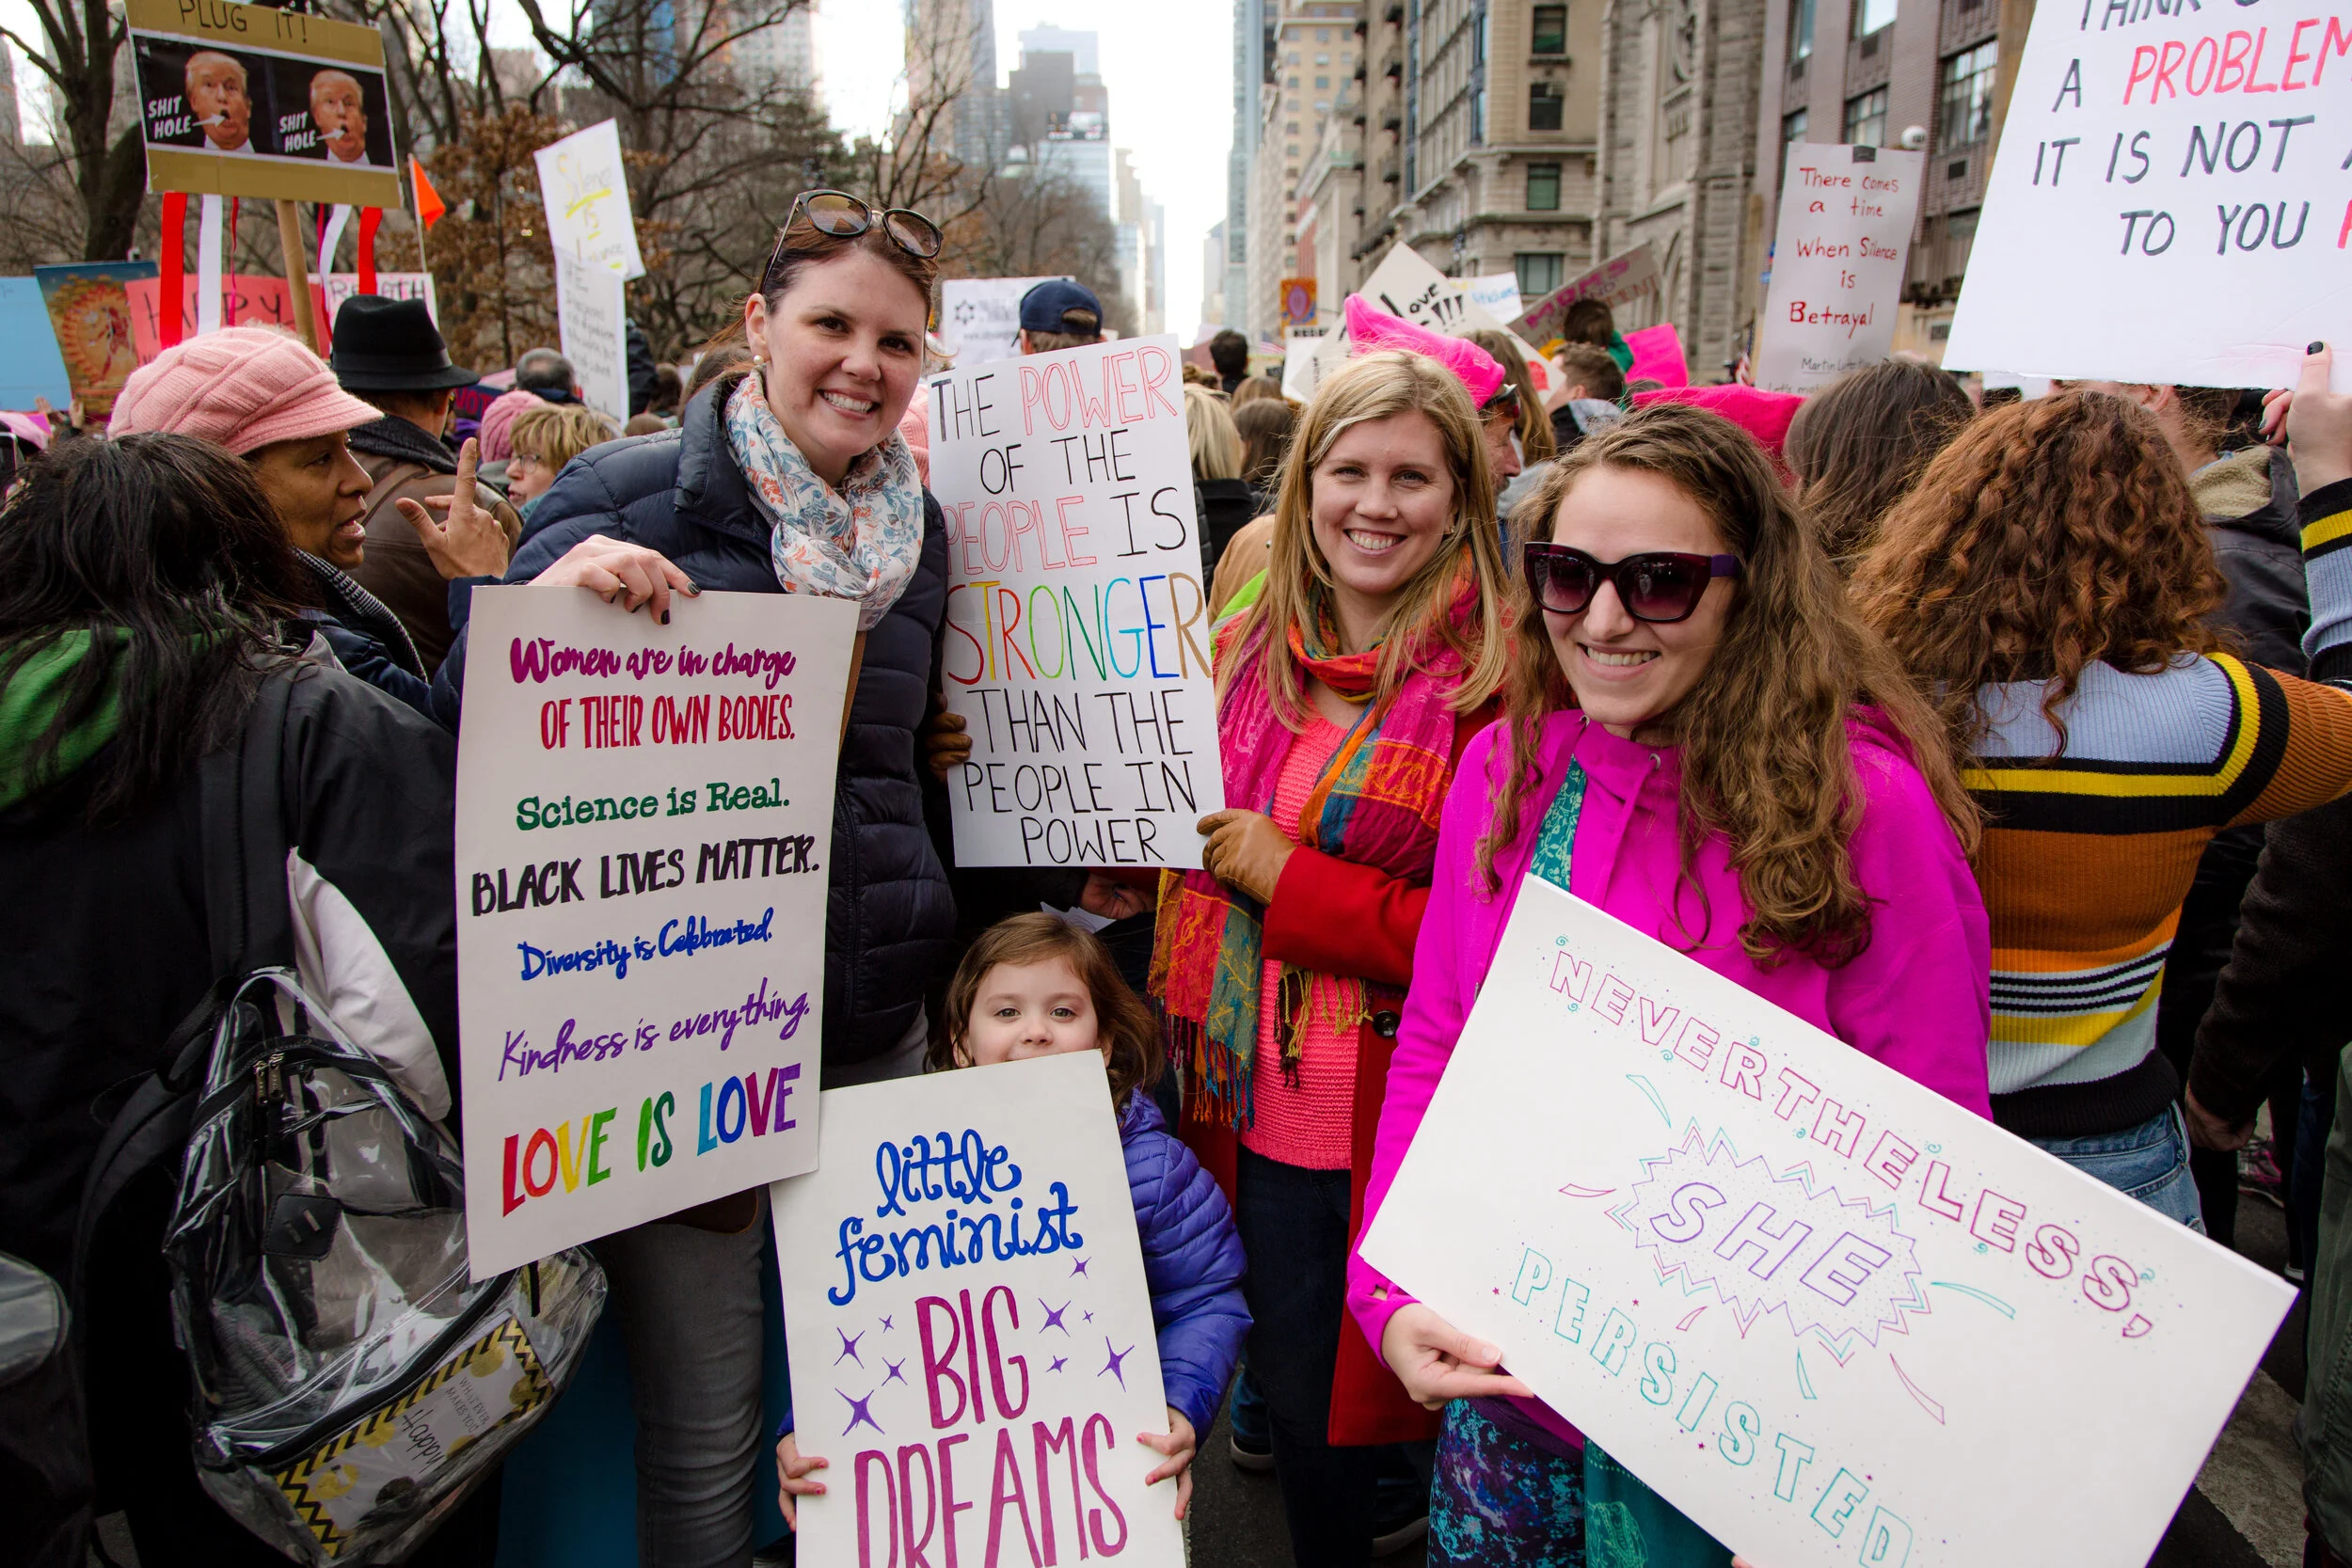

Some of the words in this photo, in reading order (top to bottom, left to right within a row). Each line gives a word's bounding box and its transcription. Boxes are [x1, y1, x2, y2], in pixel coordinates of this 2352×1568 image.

[180, 0, 247, 32] PLUG
[276, 12, 308, 43] IT!
[148, 95, 183, 119] SHIT
[2051, 58, 2082, 113] A
[153, 115, 192, 140] HOLE
[278, 111, 309, 134] SHIT
[284, 130, 316, 153] HOLE
[2032, 137, 2080, 187] IT
[2106, 131, 2151, 184] IS
[2180, 115, 2315, 178] NOT
[1800, 167, 1851, 188] There
[1809, 200, 1825, 213] a
[1851, 196, 1883, 217] time
[2120, 210, 2175, 257] TO
[2217, 200, 2311, 256] YOU
[1860, 237, 1898, 261] Silence
[1841, 270, 1856, 289] is
[1789, 301, 1875, 340] Betrayal
[1801, 357, 1836, 371] Martin
[931, 373, 1000, 442] THE
[1019, 345, 1178, 436] POWER
[979, 444, 1024, 495] OF
[1050, 429, 1136, 484] THE
[942, 495, 1097, 576] PEOPLE
[1109, 486, 1186, 558] IS
[946, 572, 1213, 685] STRONGER
[510, 637, 621, 684] Women
[626, 649, 673, 681] are
[678, 644, 708, 675] in
[711, 641, 797, 690] charge
[540, 699, 571, 750] OF
[580, 695, 644, 749] THEIR
[652, 694, 711, 745] OWN
[718, 693, 796, 742] BODIES.
[966, 688, 1087, 753] THAN
[1094, 689, 1193, 755] THE
[516, 794, 659, 832] Science
[667, 787, 696, 816] is
[706, 778, 790, 813] Real.
[963, 761, 1113, 813] PEOPLE
[1124, 760, 1197, 814] IN
[1021, 816, 1165, 864] POWER
[471, 857, 584, 916] BLACK
[599, 848, 685, 899] LIVES
[695, 833, 820, 885] MATTER.
[517, 939, 631, 981] Diversity
[634, 935, 656, 961] is
[498, 1019, 628, 1082] Kindness
[634, 1018, 660, 1052] is
[669, 976, 810, 1052] everything.
[502, 1106, 618, 1218] LOVE
[636, 1090, 675, 1172] IS
[696, 1063, 802, 1157] LOVE
[1549, 950, 2153, 1338] NEVERTHELESS,
[875, 1128, 1023, 1218] little
[827, 1181, 1085, 1307] feminist
[1649, 1180, 1893, 1307] SHE
[914, 1285, 1029, 1430] BIG
[1511, 1246, 1914, 1568] PERSISTED
[401, 1408, 446, 1475] Happy
[853, 1412, 1129, 1568] DREAMS
